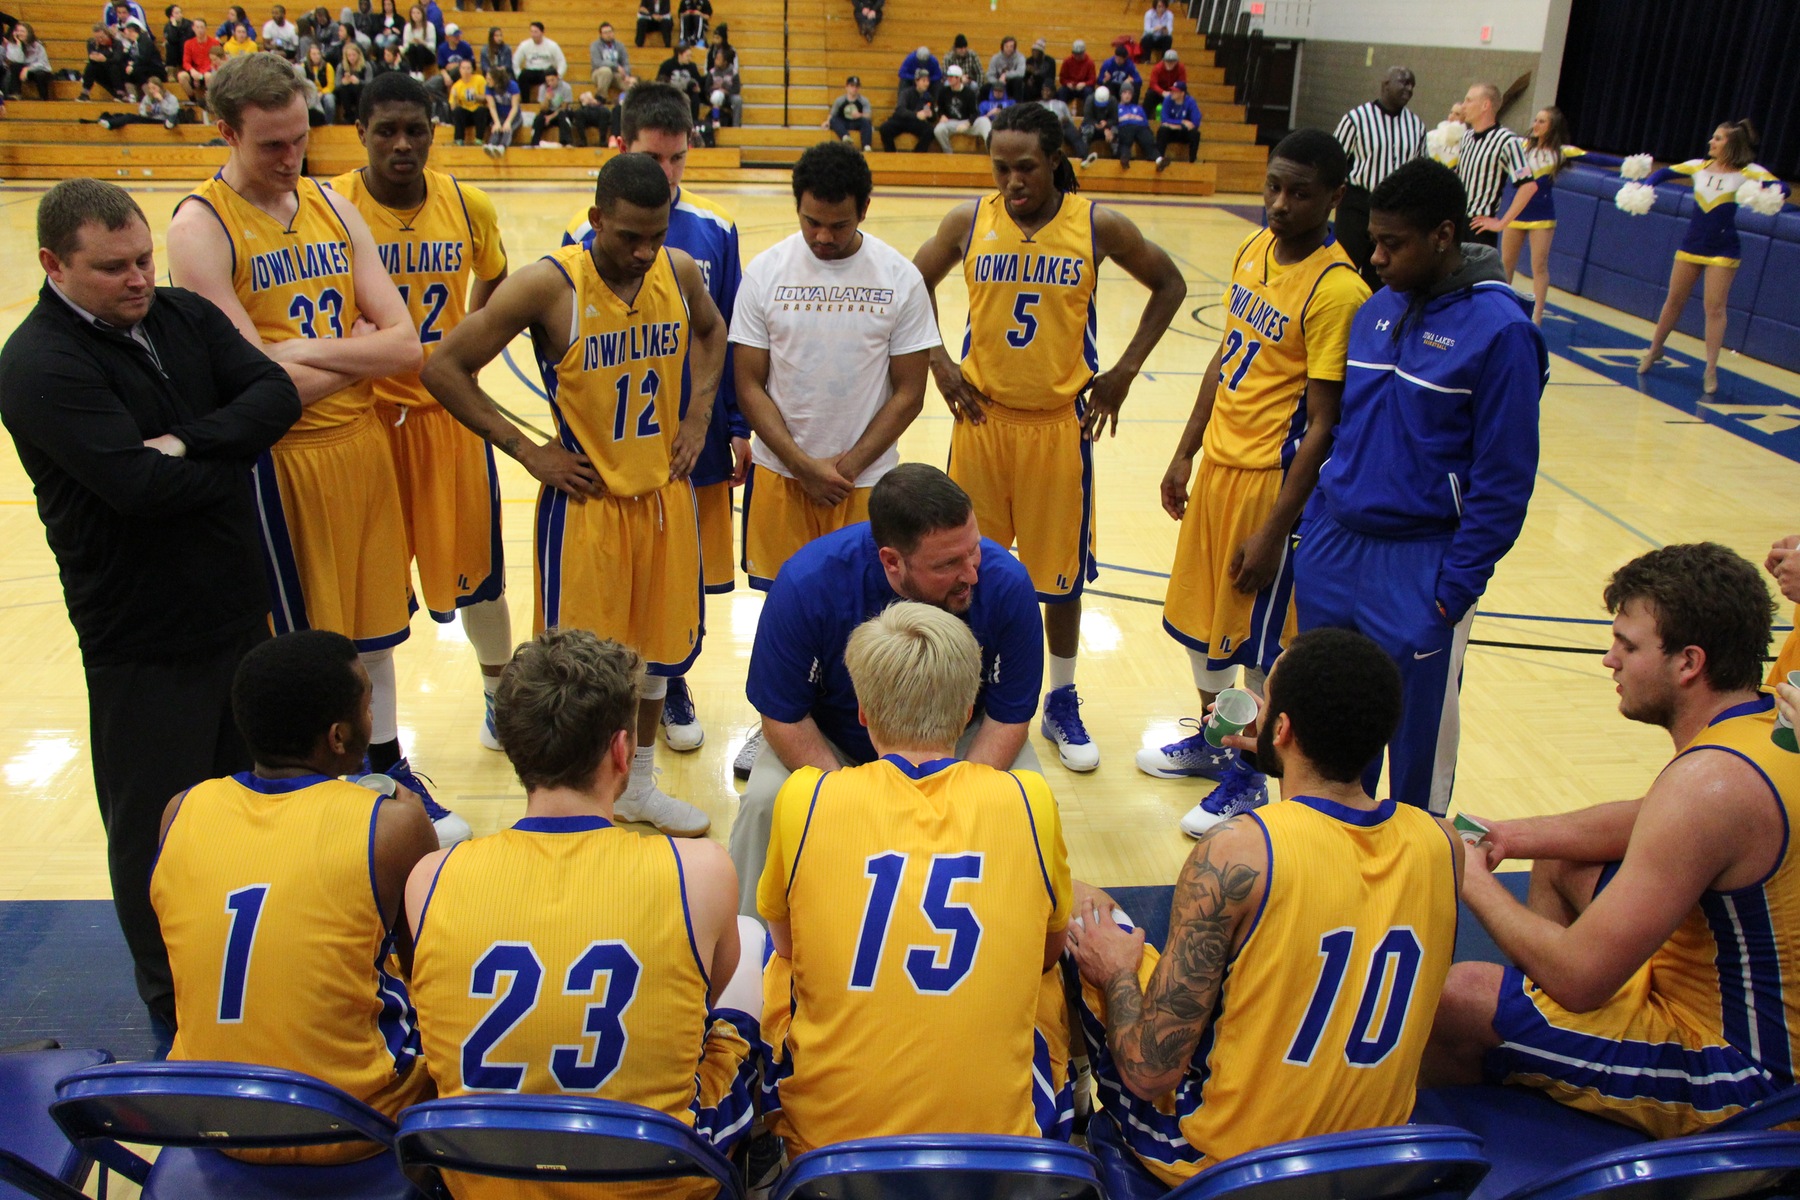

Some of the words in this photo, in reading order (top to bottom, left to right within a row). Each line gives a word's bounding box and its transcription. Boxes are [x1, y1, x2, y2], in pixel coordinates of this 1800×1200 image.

[250, 247, 297, 292] IOWA
[294, 241, 349, 279] LAKES
[406, 241, 464, 274] LAKES
[975, 253, 1018, 282] IOWA
[1022, 253, 1084, 287] LAKES
[288, 287, 344, 339] 33
[774, 285, 827, 301] IOWA
[828, 286, 893, 304] LAKES
[782, 303, 885, 314] BASKETBALL
[1005, 291, 1041, 349] 5
[1245, 296, 1290, 343] LAKES
[583, 330, 627, 372] IOWA
[1219, 328, 1261, 391] 21
[1434, 334, 1456, 347] LAKES
[613, 368, 661, 442] 12
[847, 849, 985, 996] 15
[216, 882, 271, 1025] 1
[460, 938, 644, 1094] 23
[1282, 924, 1425, 1069] 10
